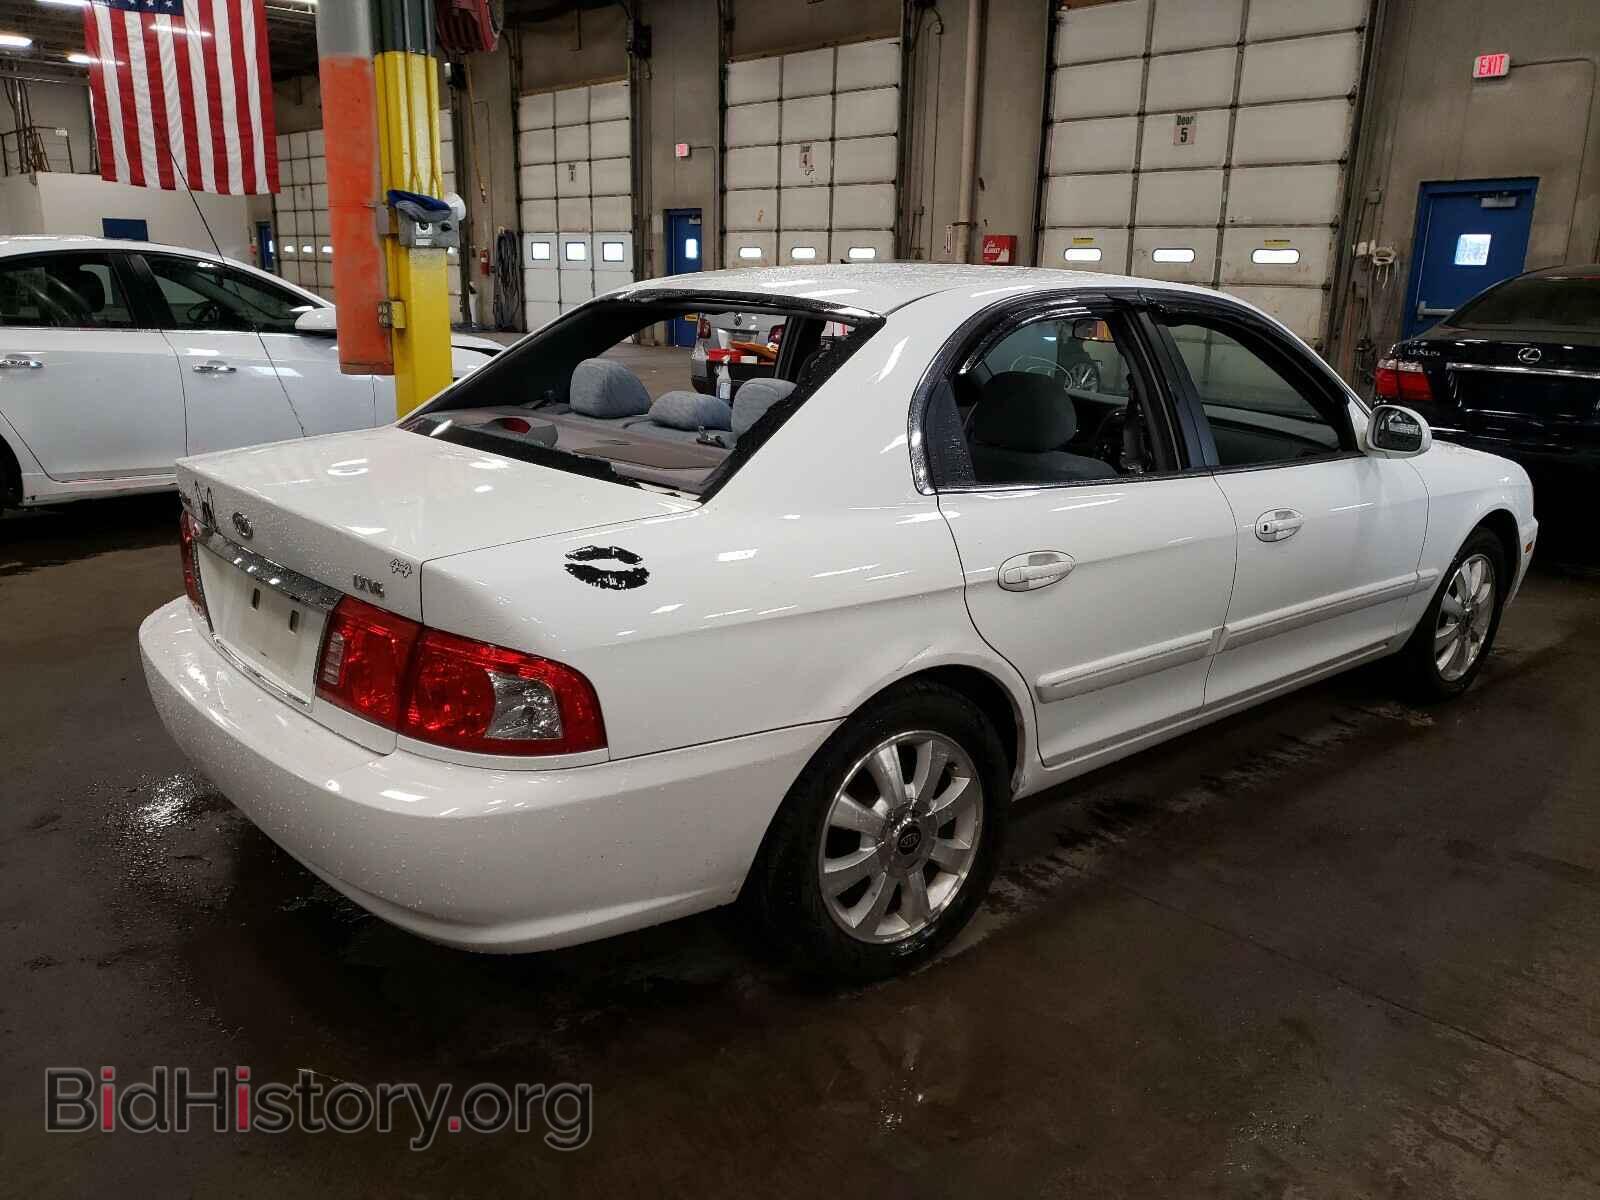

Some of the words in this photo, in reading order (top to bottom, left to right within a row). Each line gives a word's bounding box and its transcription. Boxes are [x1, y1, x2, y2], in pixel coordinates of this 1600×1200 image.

[1479, 55, 1505, 76] EXIT
[1176, 114, 1194, 126] Door
[1180, 127, 1189, 143] 5
